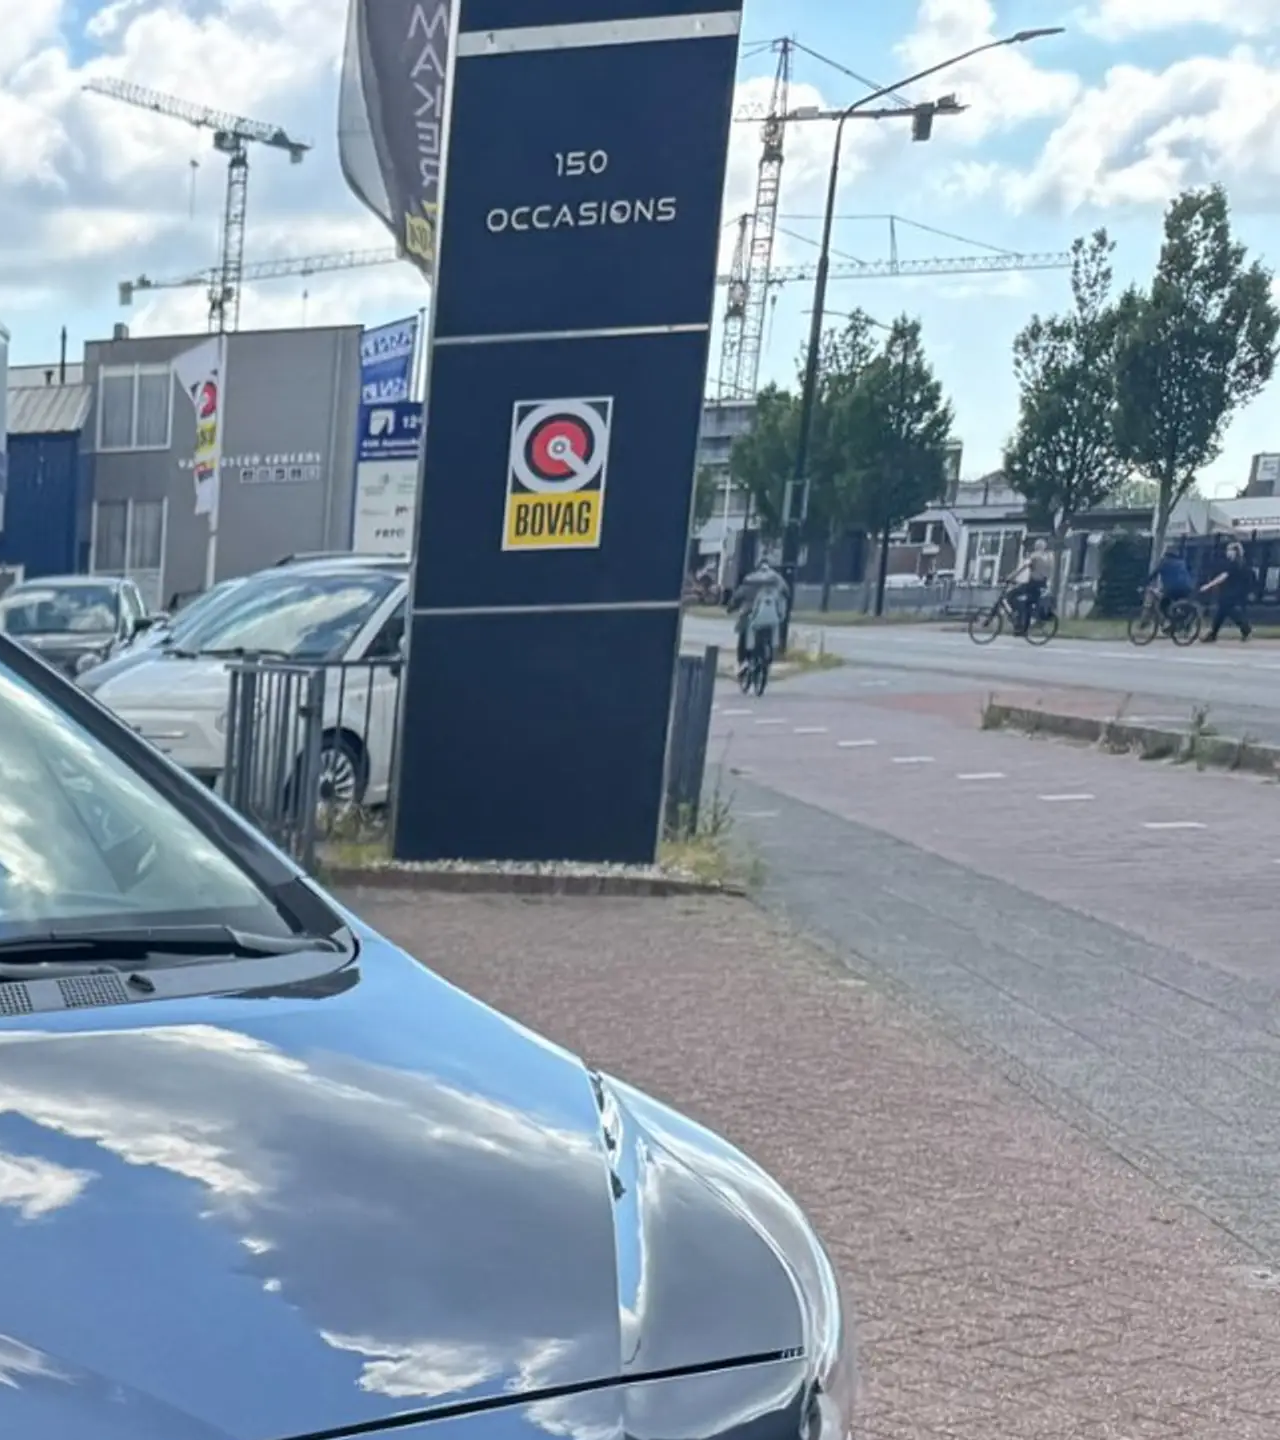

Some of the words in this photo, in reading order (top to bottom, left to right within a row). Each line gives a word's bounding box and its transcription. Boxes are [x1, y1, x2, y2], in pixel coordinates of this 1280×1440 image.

[554, 149, 608, 176] 150
[486, 197, 677, 232] OCCASIONS
[515, 499, 592, 538] BOVAG
